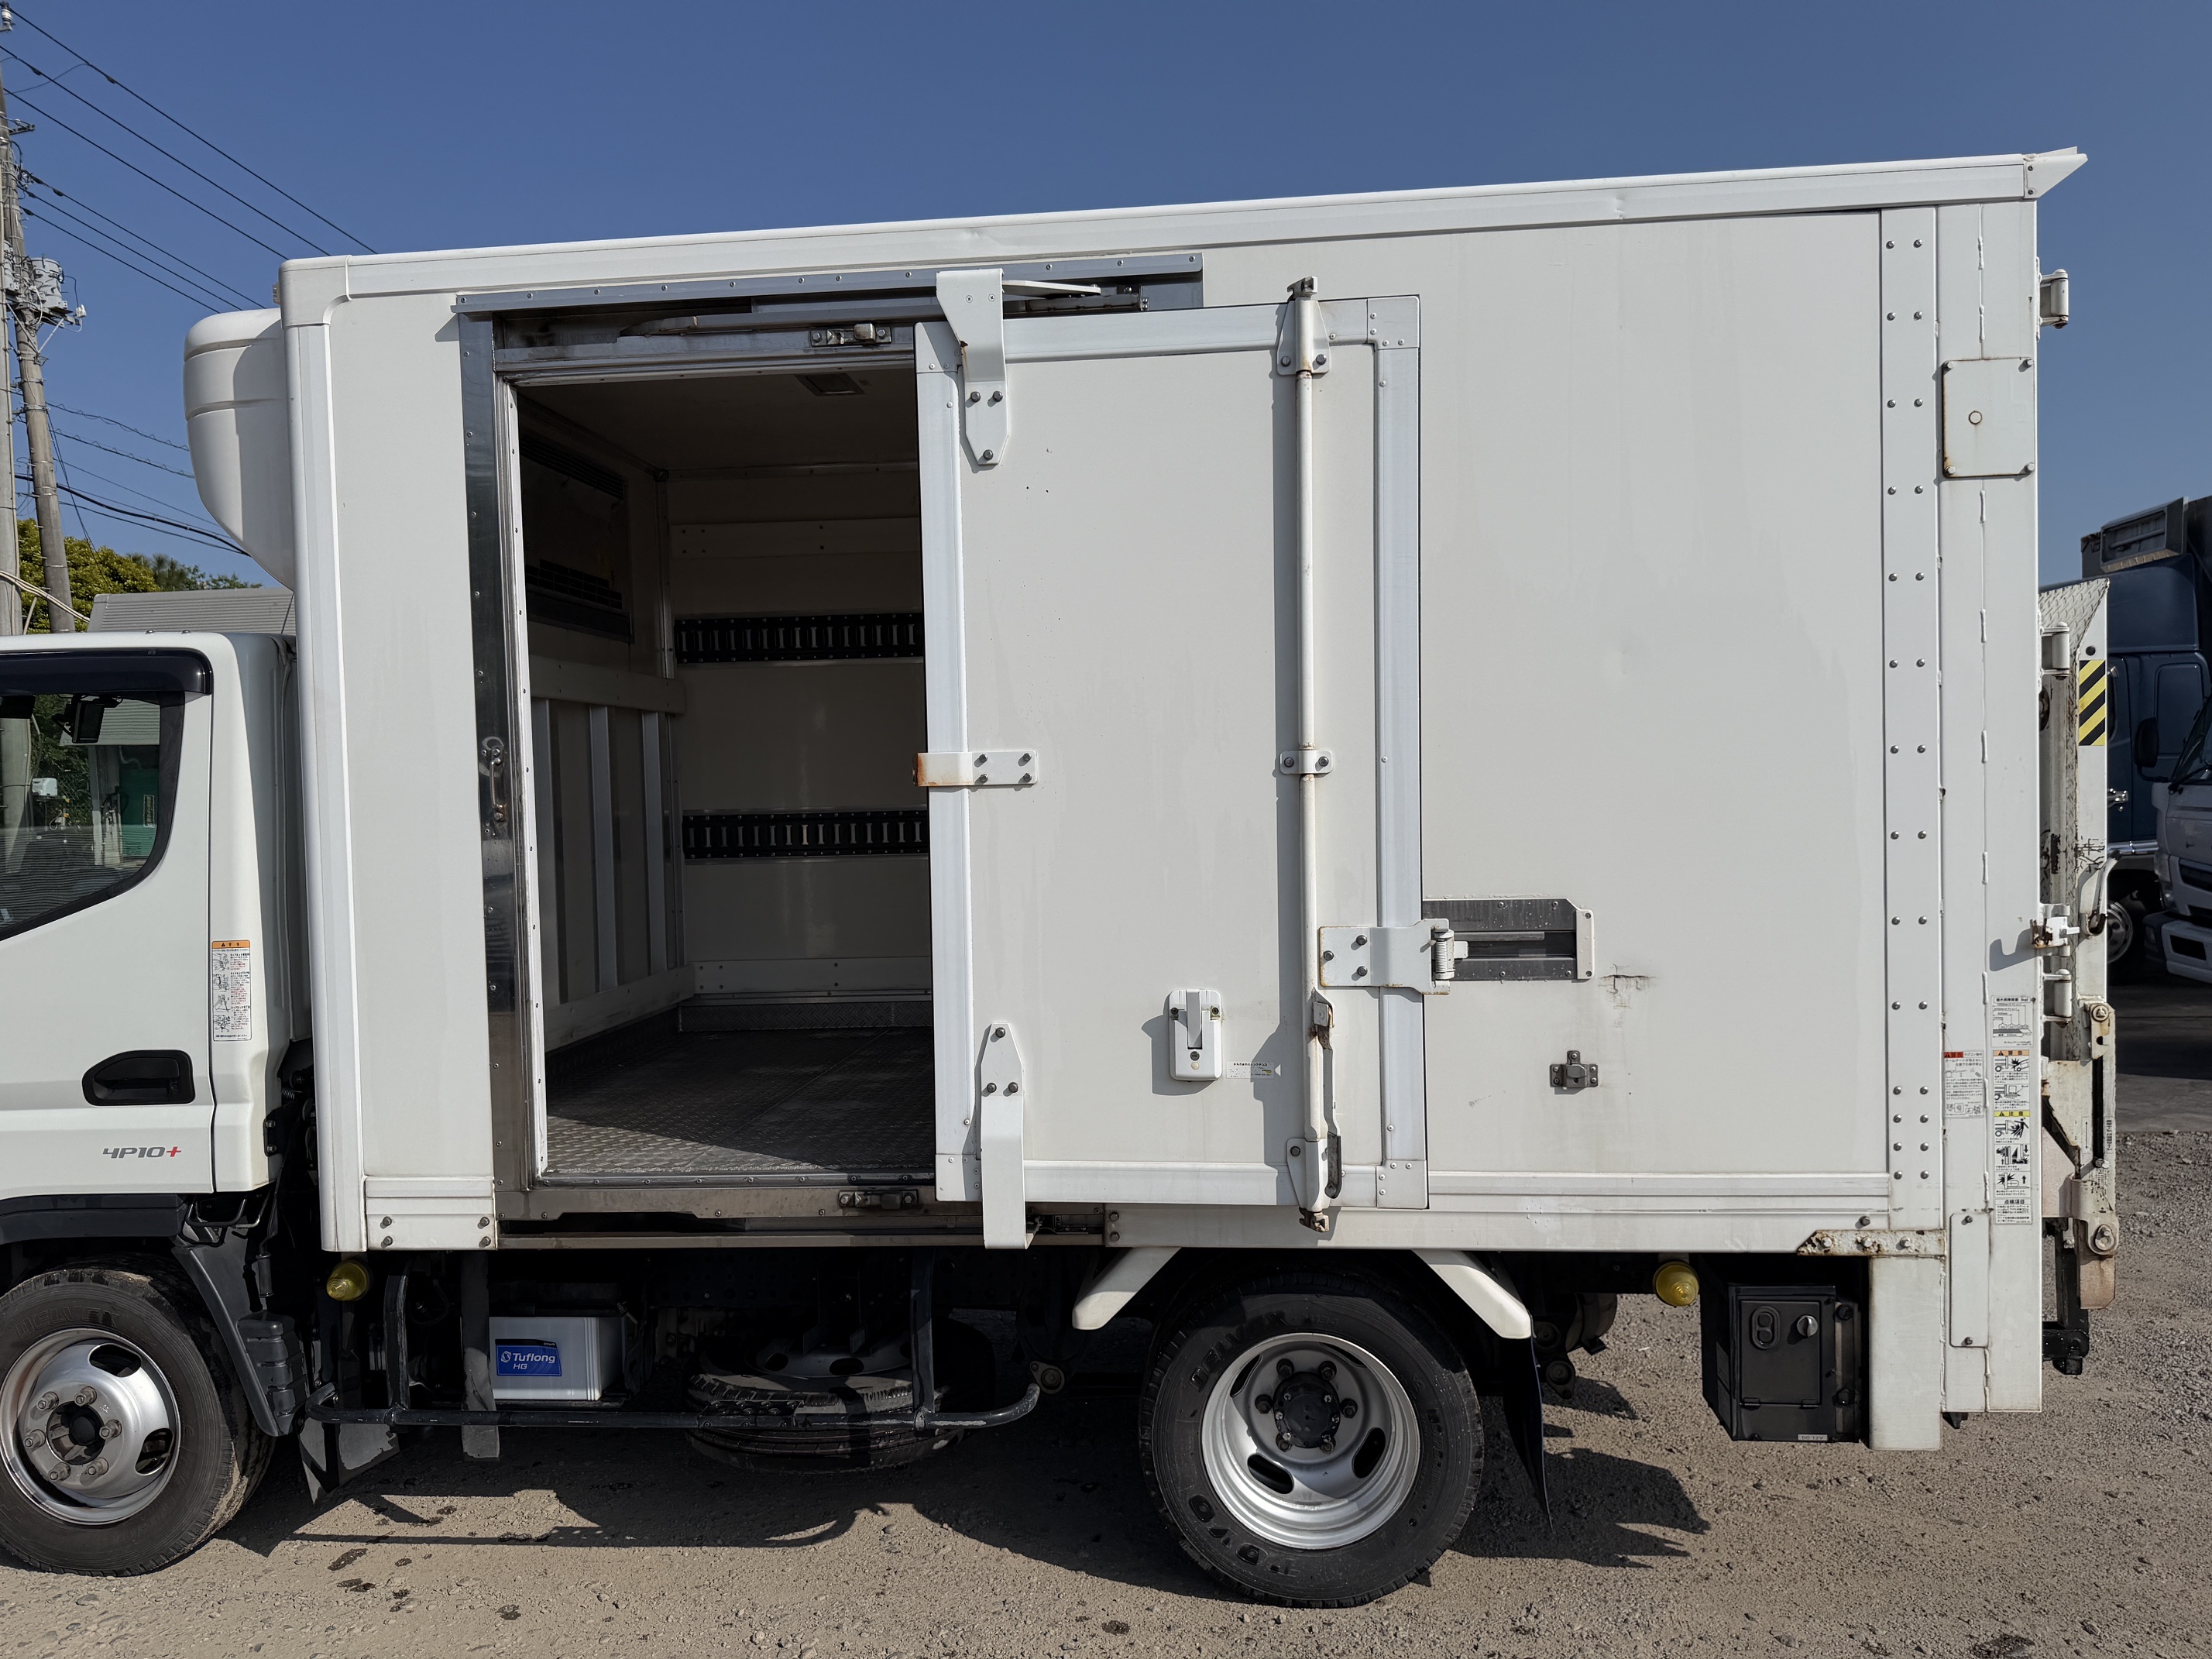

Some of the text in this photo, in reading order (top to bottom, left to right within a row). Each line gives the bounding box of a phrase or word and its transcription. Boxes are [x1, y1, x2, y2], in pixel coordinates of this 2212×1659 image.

[15, 1307, 120, 1341] DELVEX
[512, 1352, 556, 1364] Tuflong
[1188, 1493, 1303, 1578] TOYO
